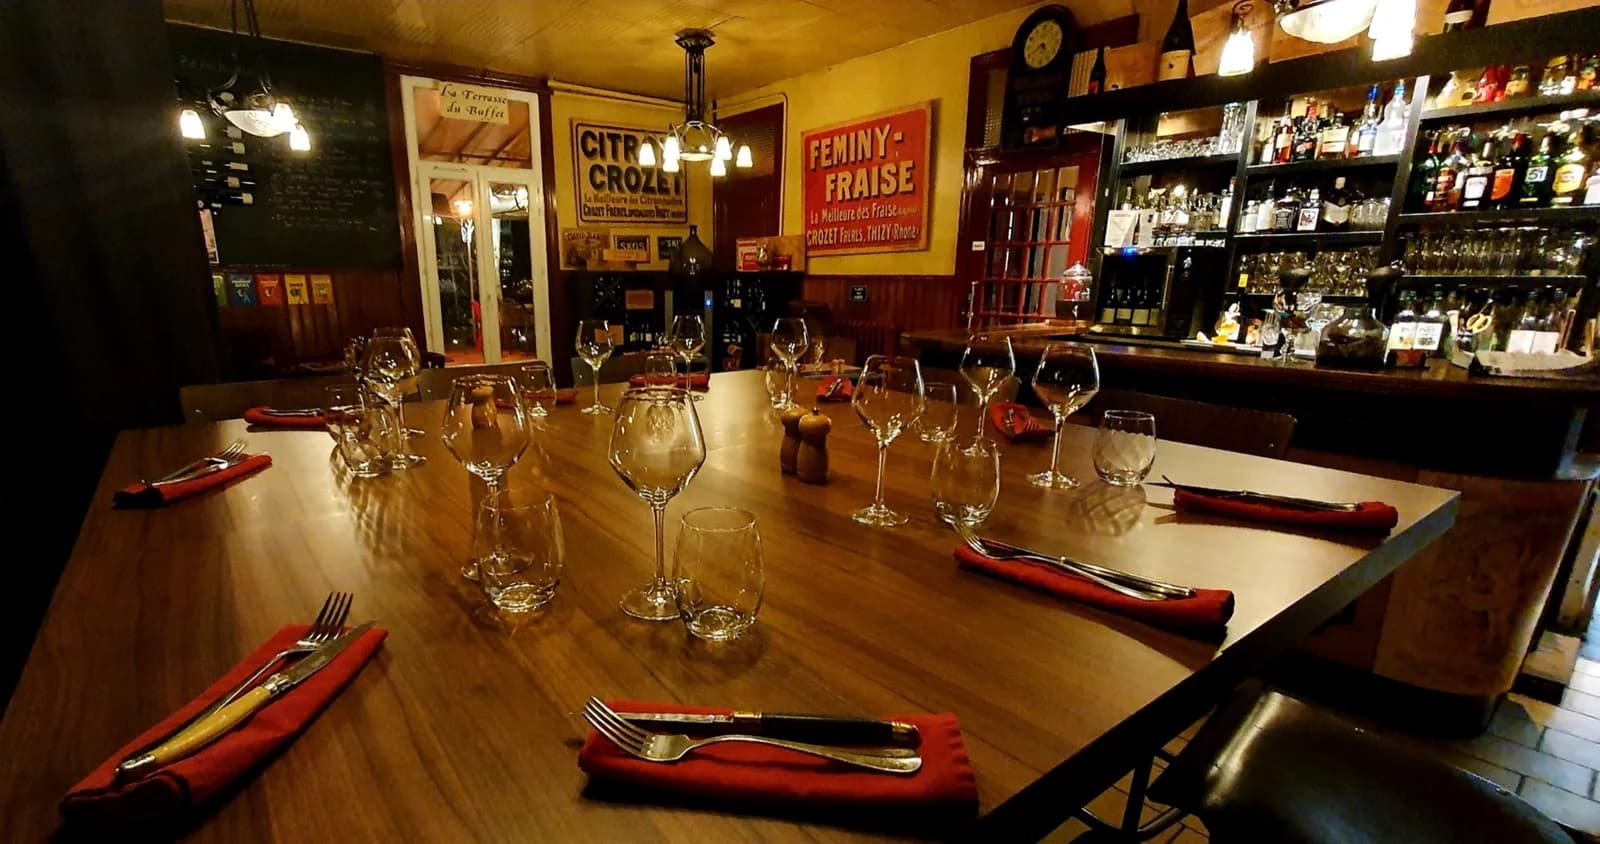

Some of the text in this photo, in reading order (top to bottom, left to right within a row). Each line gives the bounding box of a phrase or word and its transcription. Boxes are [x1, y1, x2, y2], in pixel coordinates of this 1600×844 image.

[440, 84, 510, 104] La Terrasse
[447, 101, 504, 119] du Buffet
[810, 124, 903, 170] FEMINY-
[589, 164, 682, 195] CROZET
[826, 160, 915, 202] FRAISE
[1528, 168, 1544, 180] 51
[811, 210, 819, 224] La
[821, 207, 856, 222] Meilleure
[857, 205, 869, 219] des
[806, 227, 839, 246] CROZET
[867, 224, 892, 241] THIZY
